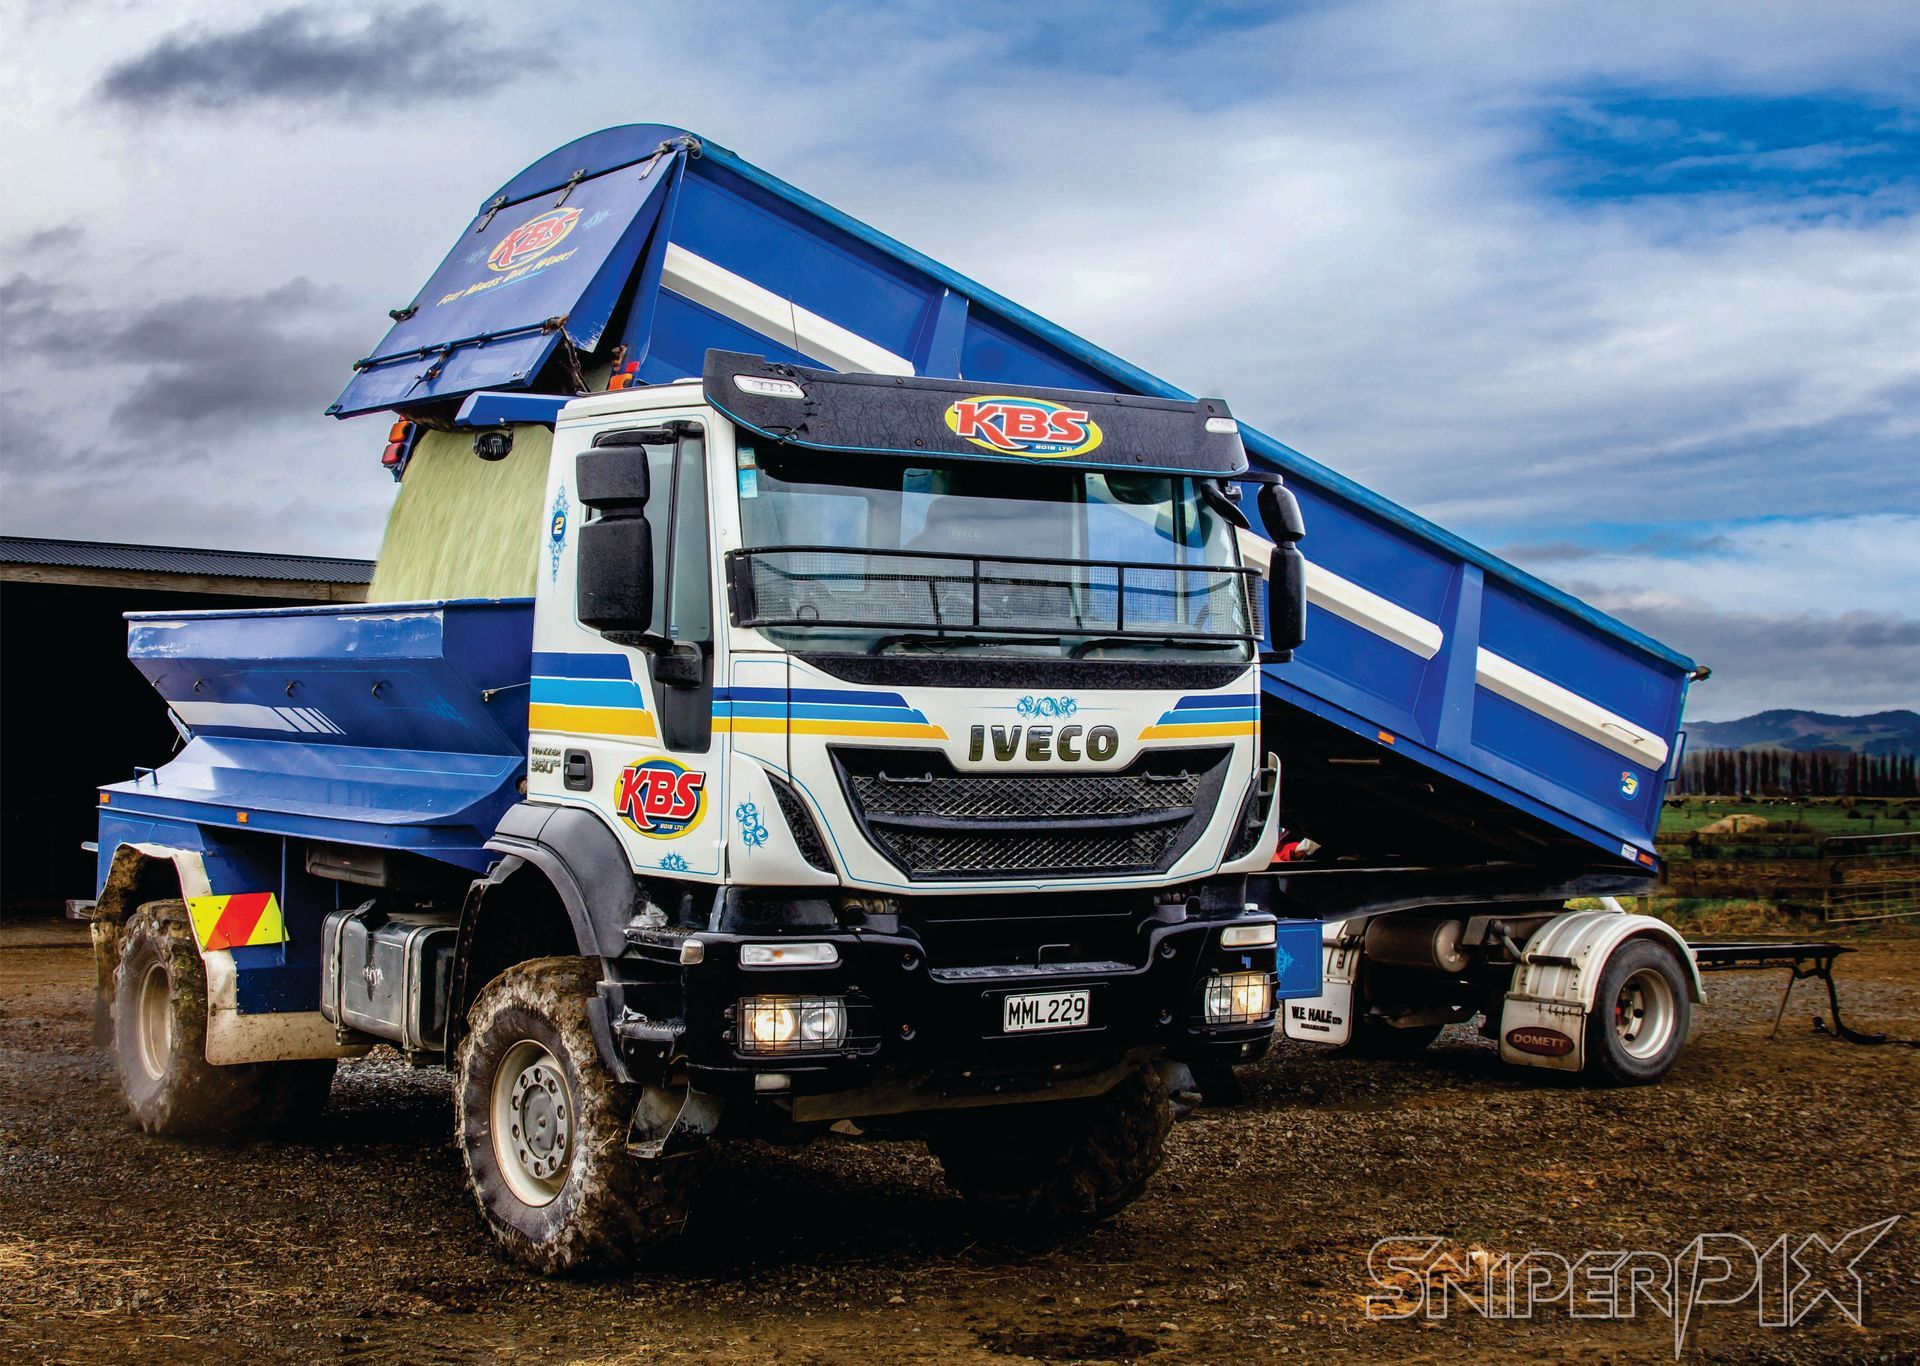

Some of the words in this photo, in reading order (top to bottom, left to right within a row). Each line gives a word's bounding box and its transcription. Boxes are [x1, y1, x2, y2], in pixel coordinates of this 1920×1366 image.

[487, 208, 584, 268] KBS
[953, 401, 1088, 450] KBS
[552, 516, 565, 535] 2
[968, 724, 1119, 762] IVECO
[618, 766, 706, 832] KBS
[1008, 997, 1086, 1026] MML229
[1308, 1007, 1333, 1025] HALE
[1512, 1033, 1567, 1048] DOMETT
